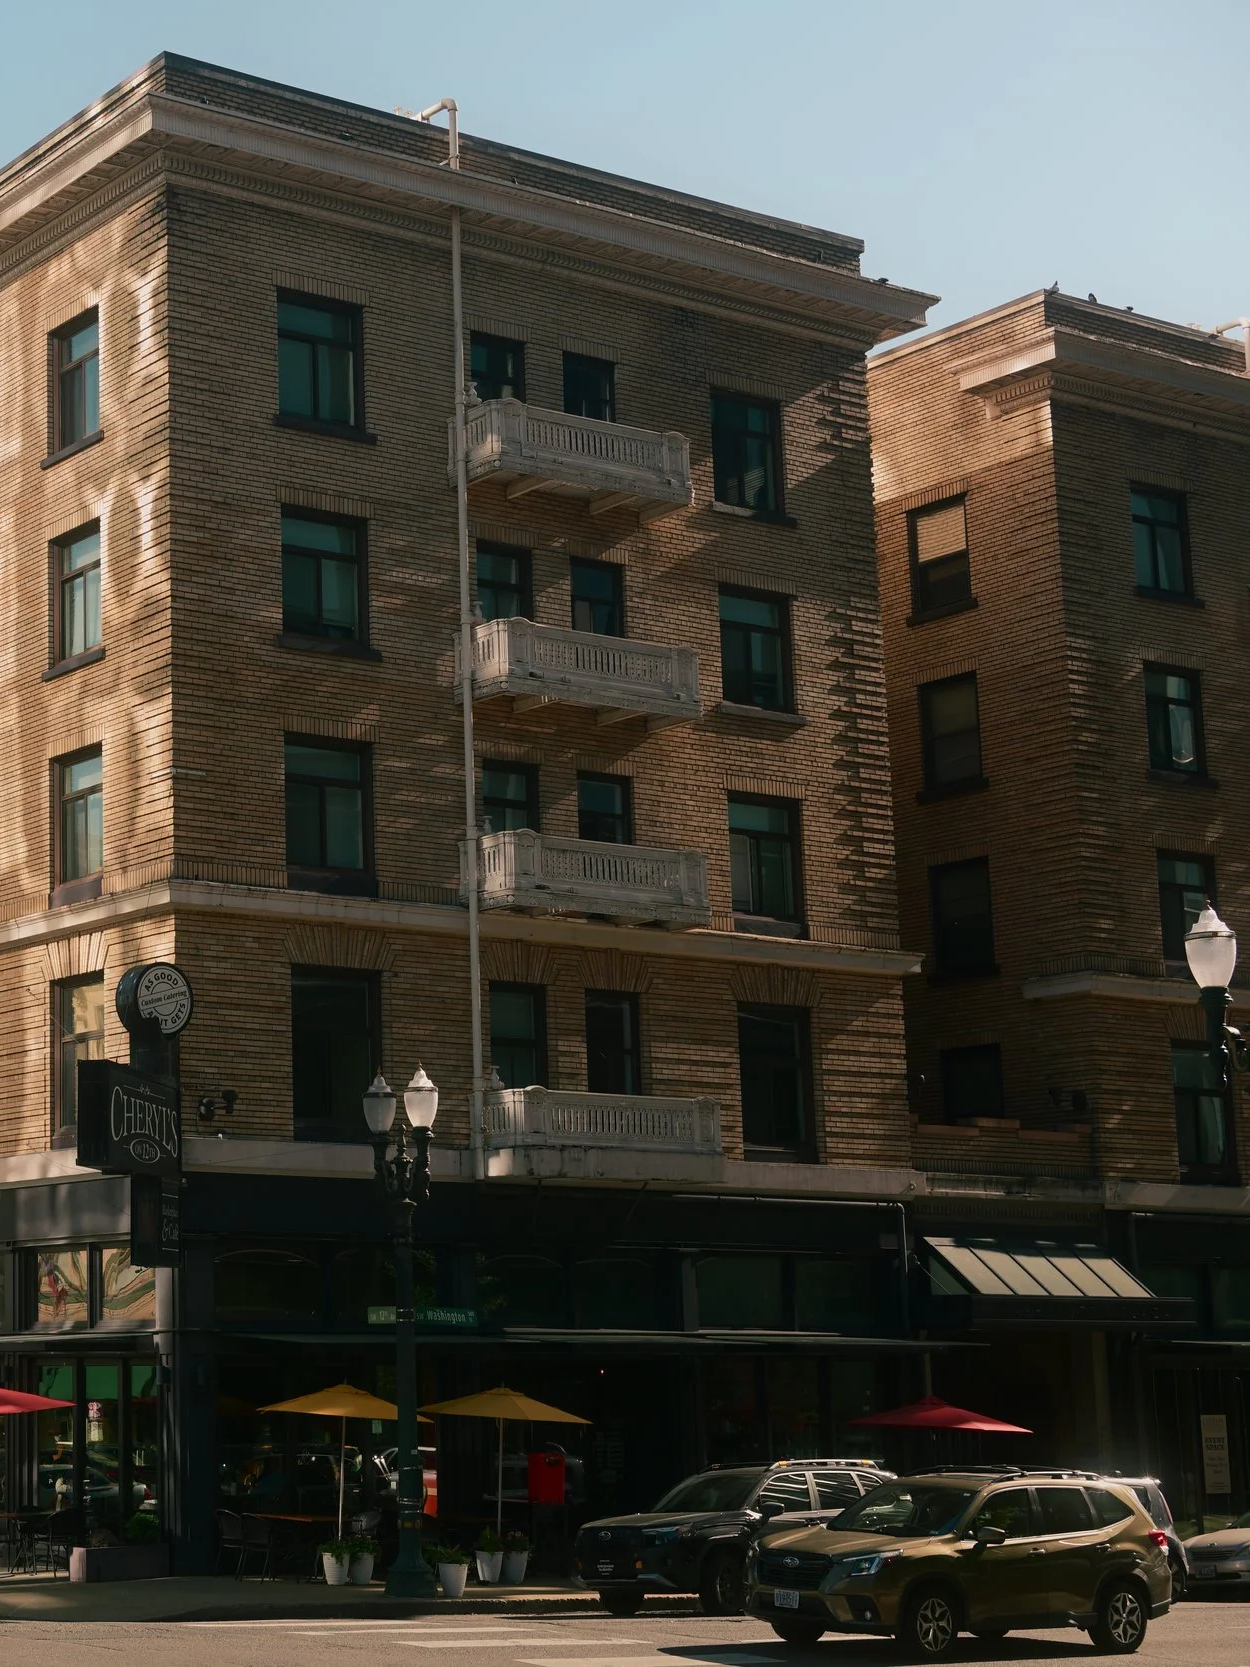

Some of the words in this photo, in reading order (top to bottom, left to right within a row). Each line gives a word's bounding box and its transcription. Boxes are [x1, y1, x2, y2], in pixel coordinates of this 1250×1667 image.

[144, 978, 154, 992] AS
[154, 972, 179, 986] GOOD
[141, 996, 162, 1007] Custom
[163, 989, 187, 1002] Catering
[171, 1003, 186, 1024] GETS
[110, 1086, 179, 1158] CHERYL'S
[426, 1309, 467, 1324] Washington
